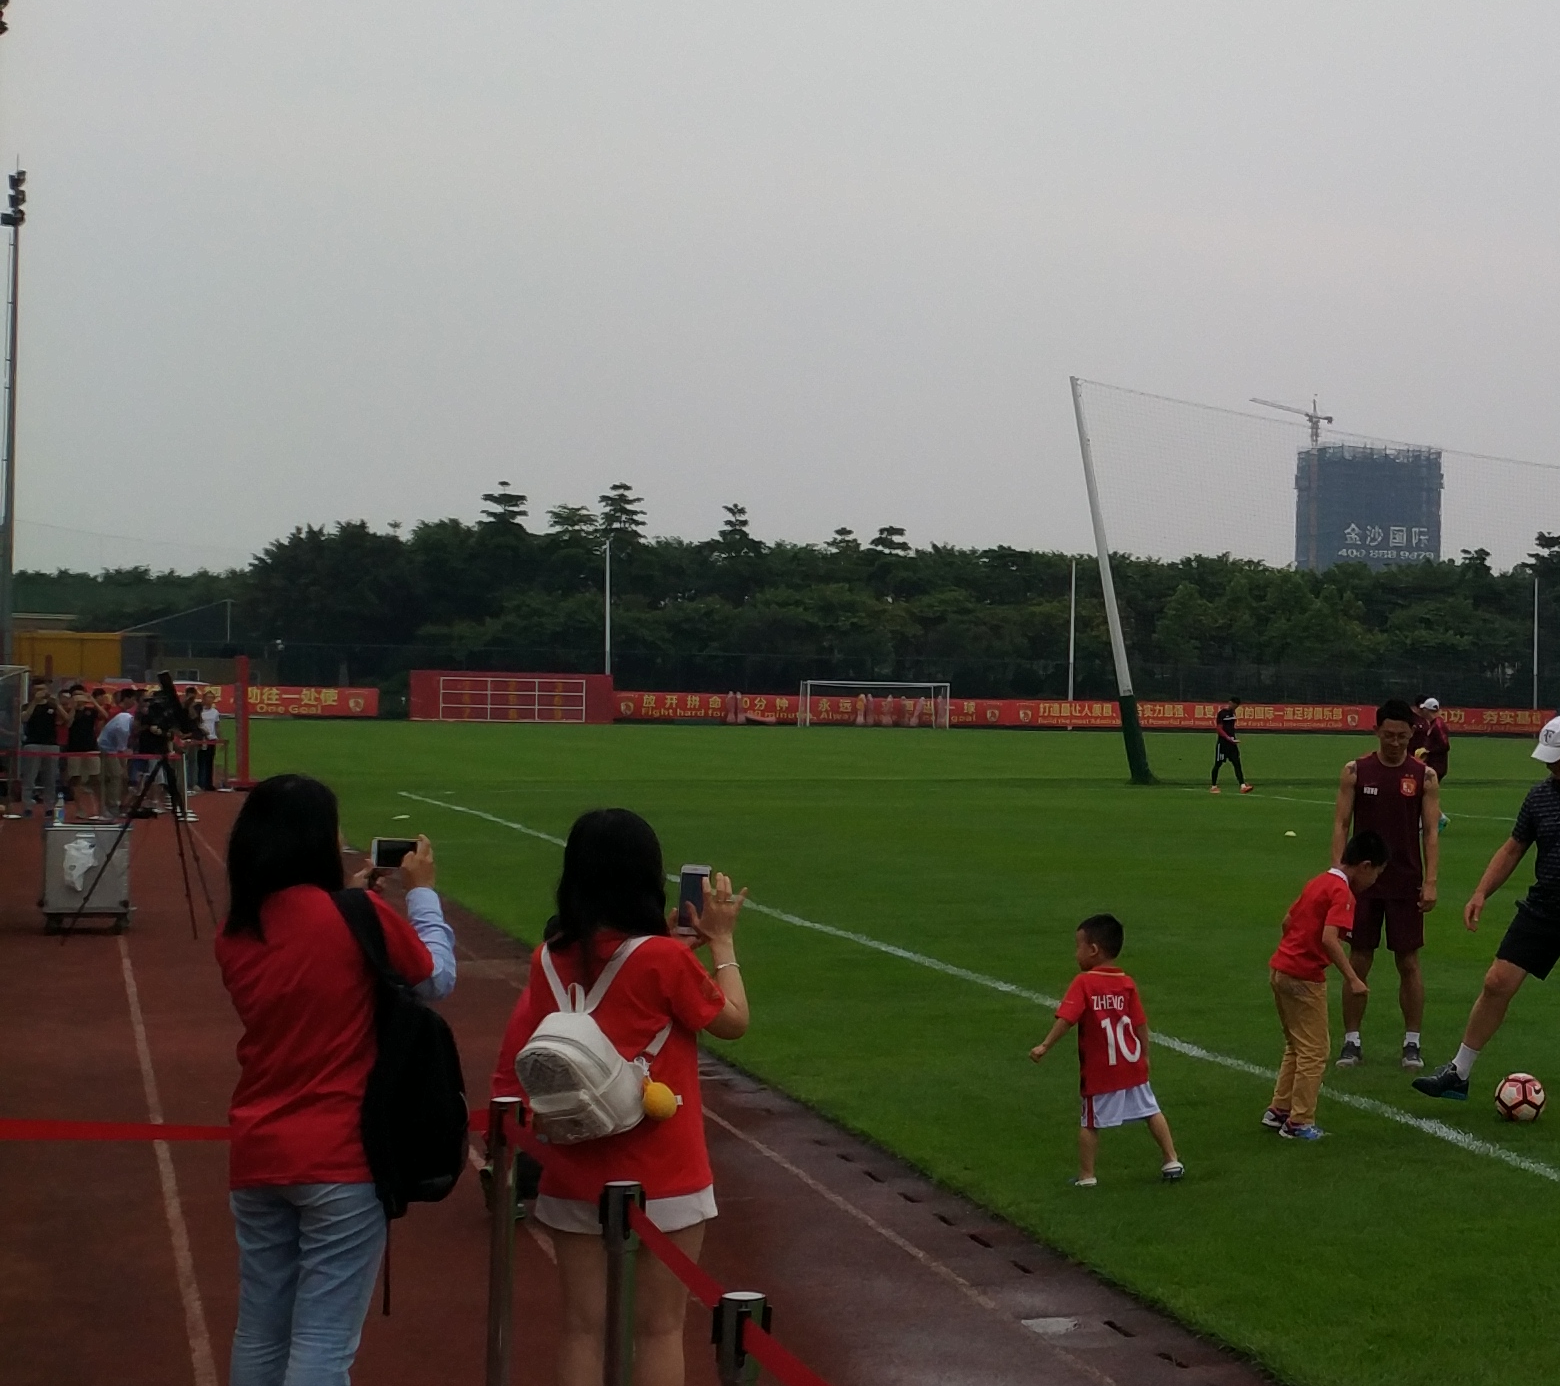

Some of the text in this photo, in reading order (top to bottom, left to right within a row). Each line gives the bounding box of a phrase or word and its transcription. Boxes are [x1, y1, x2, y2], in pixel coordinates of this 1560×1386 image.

[1343, 523, 1430, 547] 金沙国际
[257, 704, 322, 714] One Goal
[641, 708, 674, 718] Fight
[676, 709, 704, 717] hard
[708, 709, 725, 717] for
[1091, 994, 1125, 1011] ZHENG
[1101, 1014, 1142, 1066] 10
